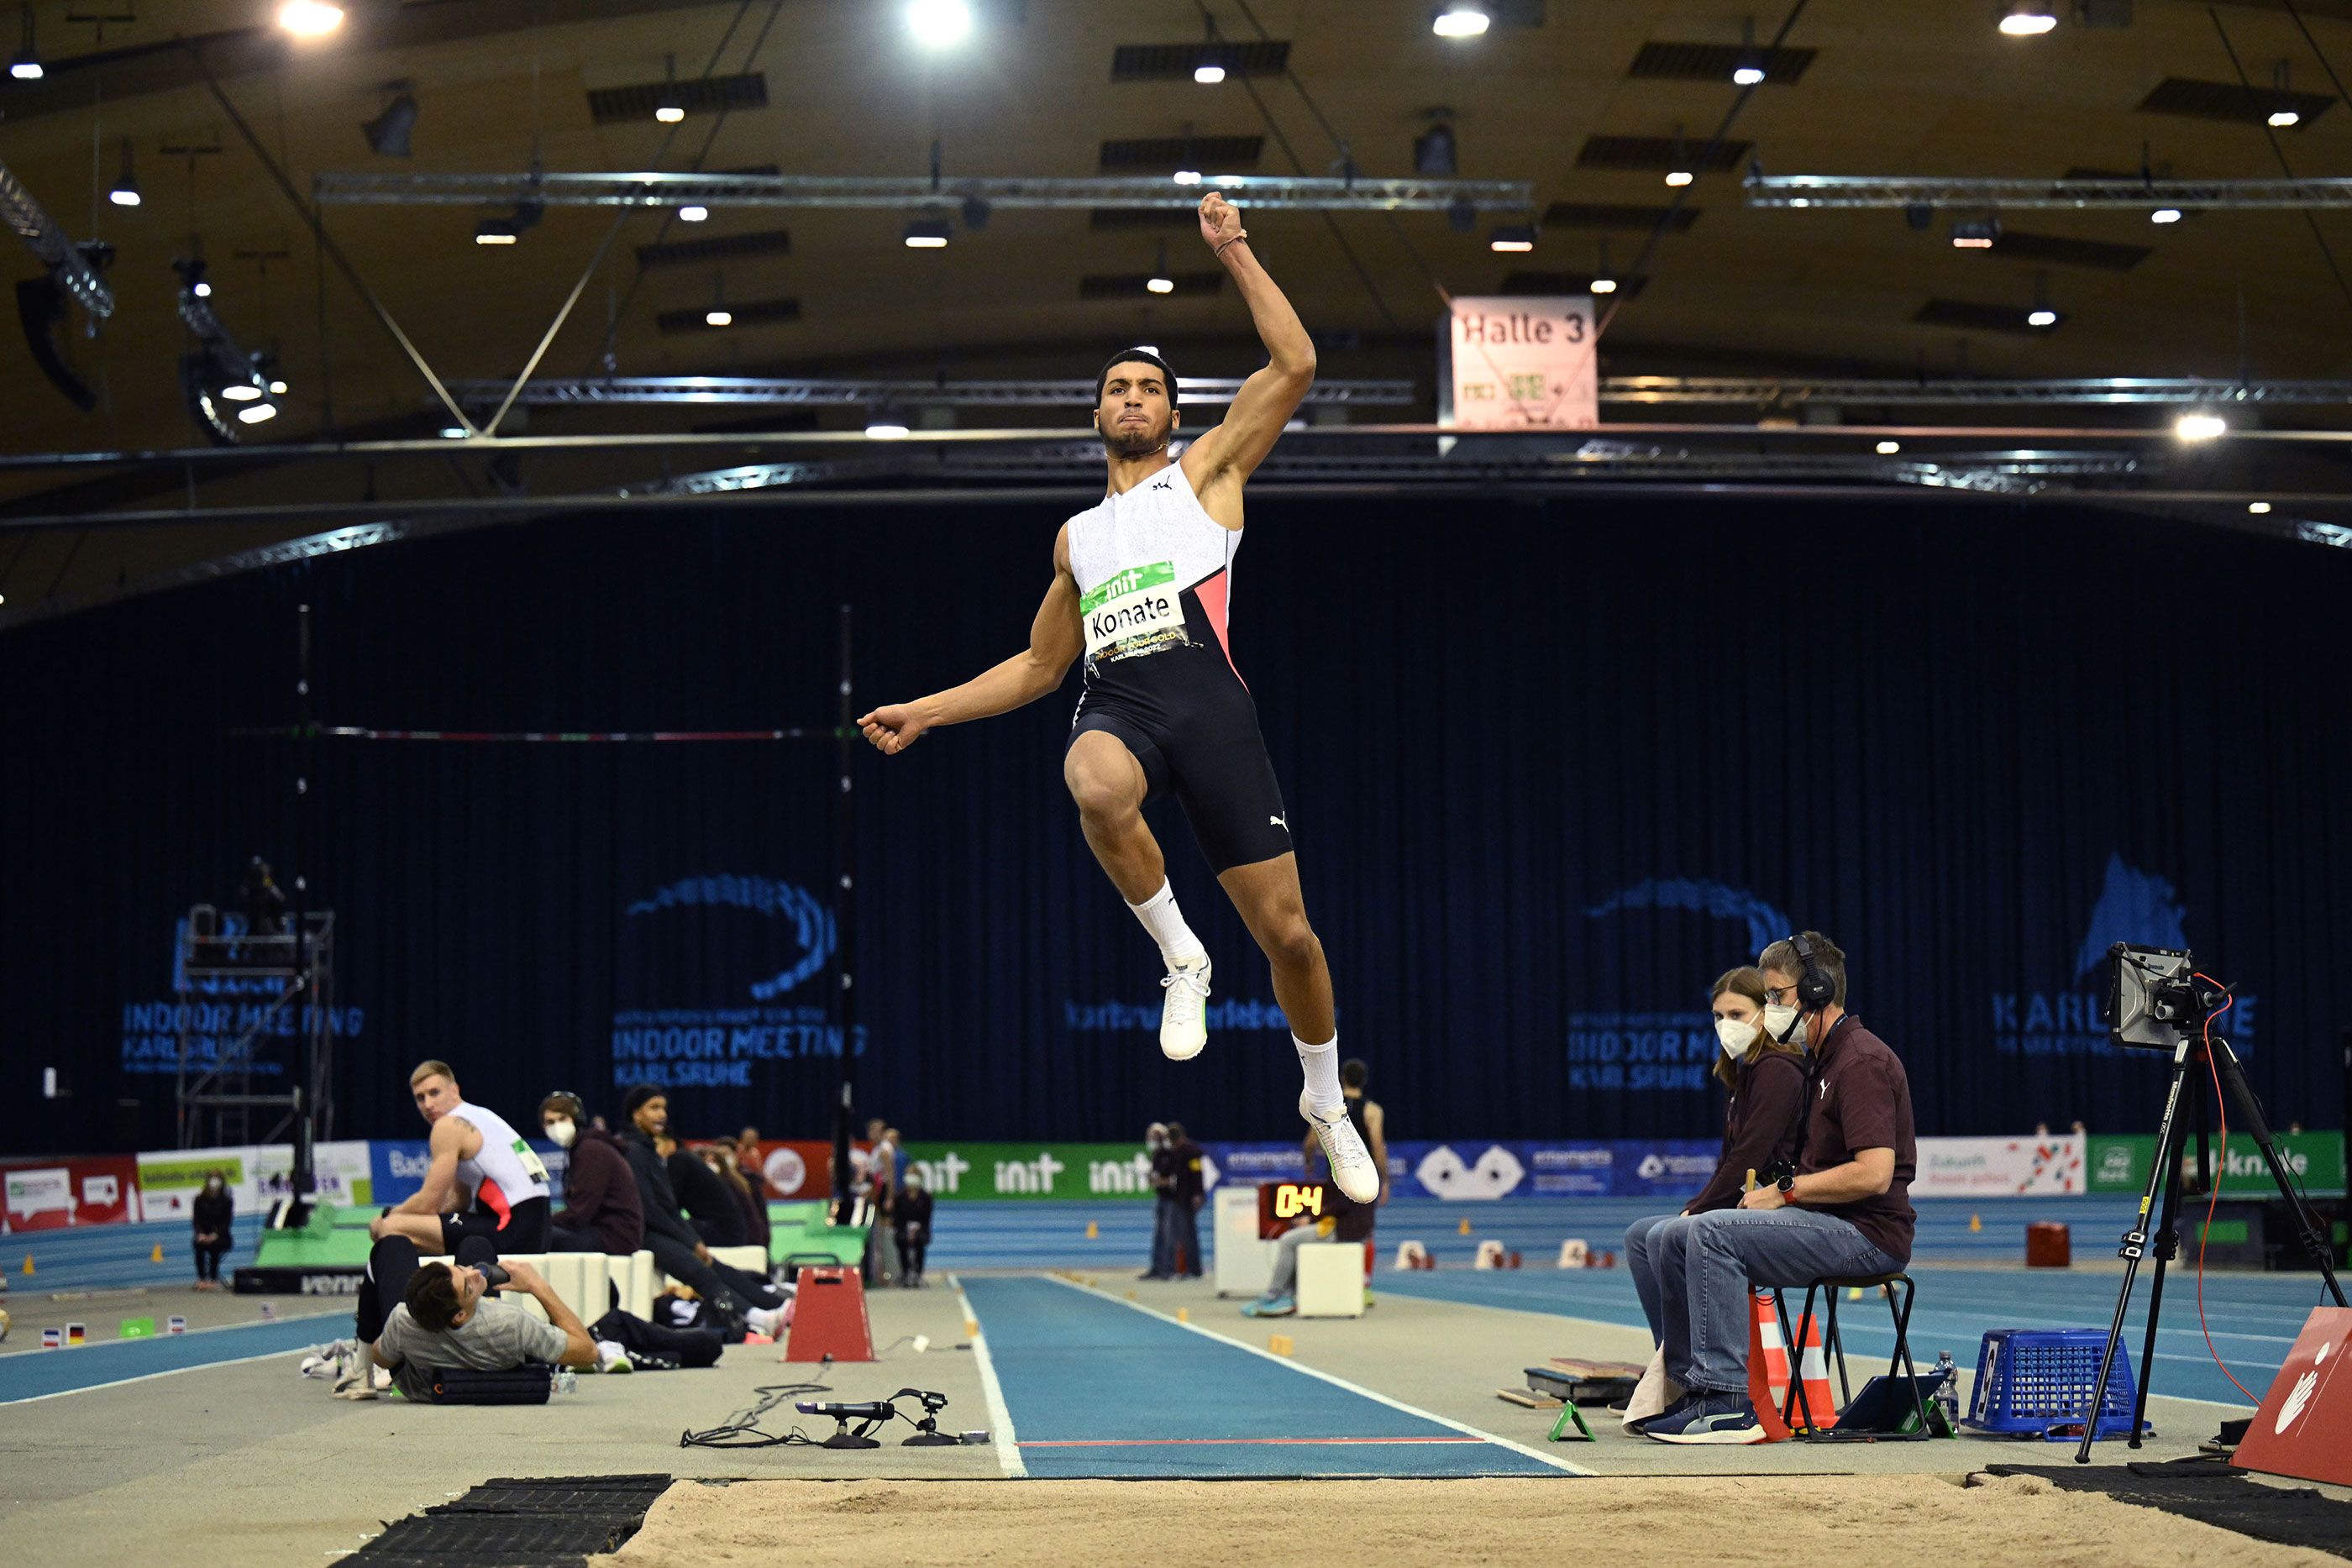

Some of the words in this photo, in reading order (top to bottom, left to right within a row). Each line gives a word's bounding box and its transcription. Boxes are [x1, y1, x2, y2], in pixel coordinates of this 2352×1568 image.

[1463, 313, 1552, 344] Halle
[1565, 312, 1585, 344] 3
[1105, 569, 1143, 602] init
[1092, 595, 1169, 640] Konate
[612, 1026, 724, 1060] INDOOR
[994, 1152, 1064, 1193] init
[1089, 1152, 1152, 1193] init
[1275, 1185, 1323, 1218] 0:4
